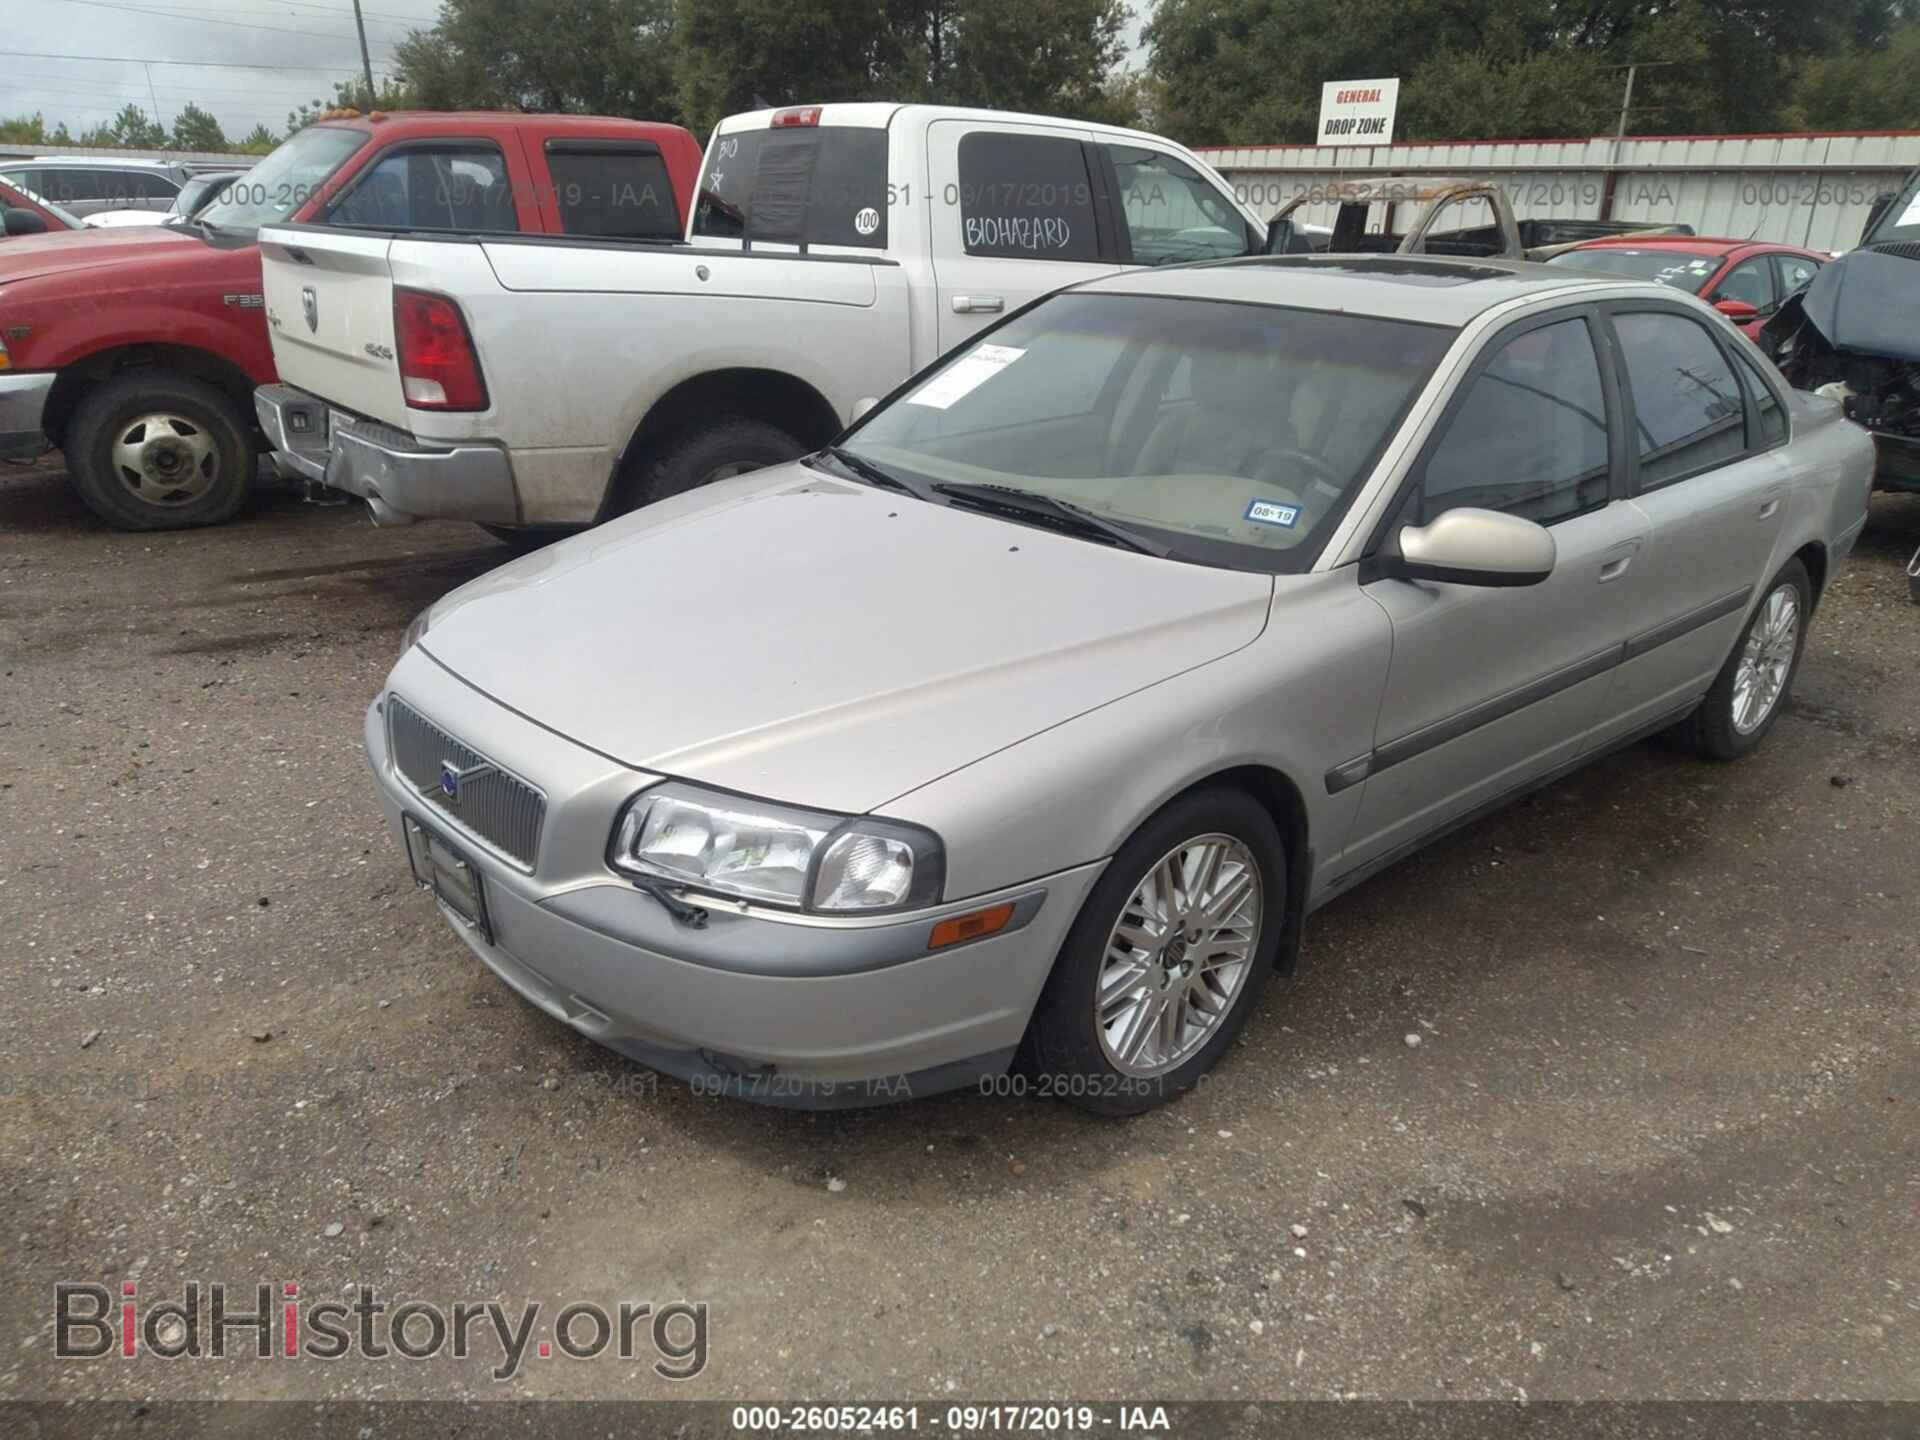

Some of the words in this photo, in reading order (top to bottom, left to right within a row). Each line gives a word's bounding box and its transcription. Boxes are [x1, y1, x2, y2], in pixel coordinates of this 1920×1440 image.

[1336, 89, 1381, 104] GENERAL
[1325, 119, 1356, 135] DROP
[1356, 117, 1387, 134] ZONE
[718, 139, 738, 161] BIO
[857, 212, 878, 229] 100
[966, 217, 1070, 249] BIOHAZARD
